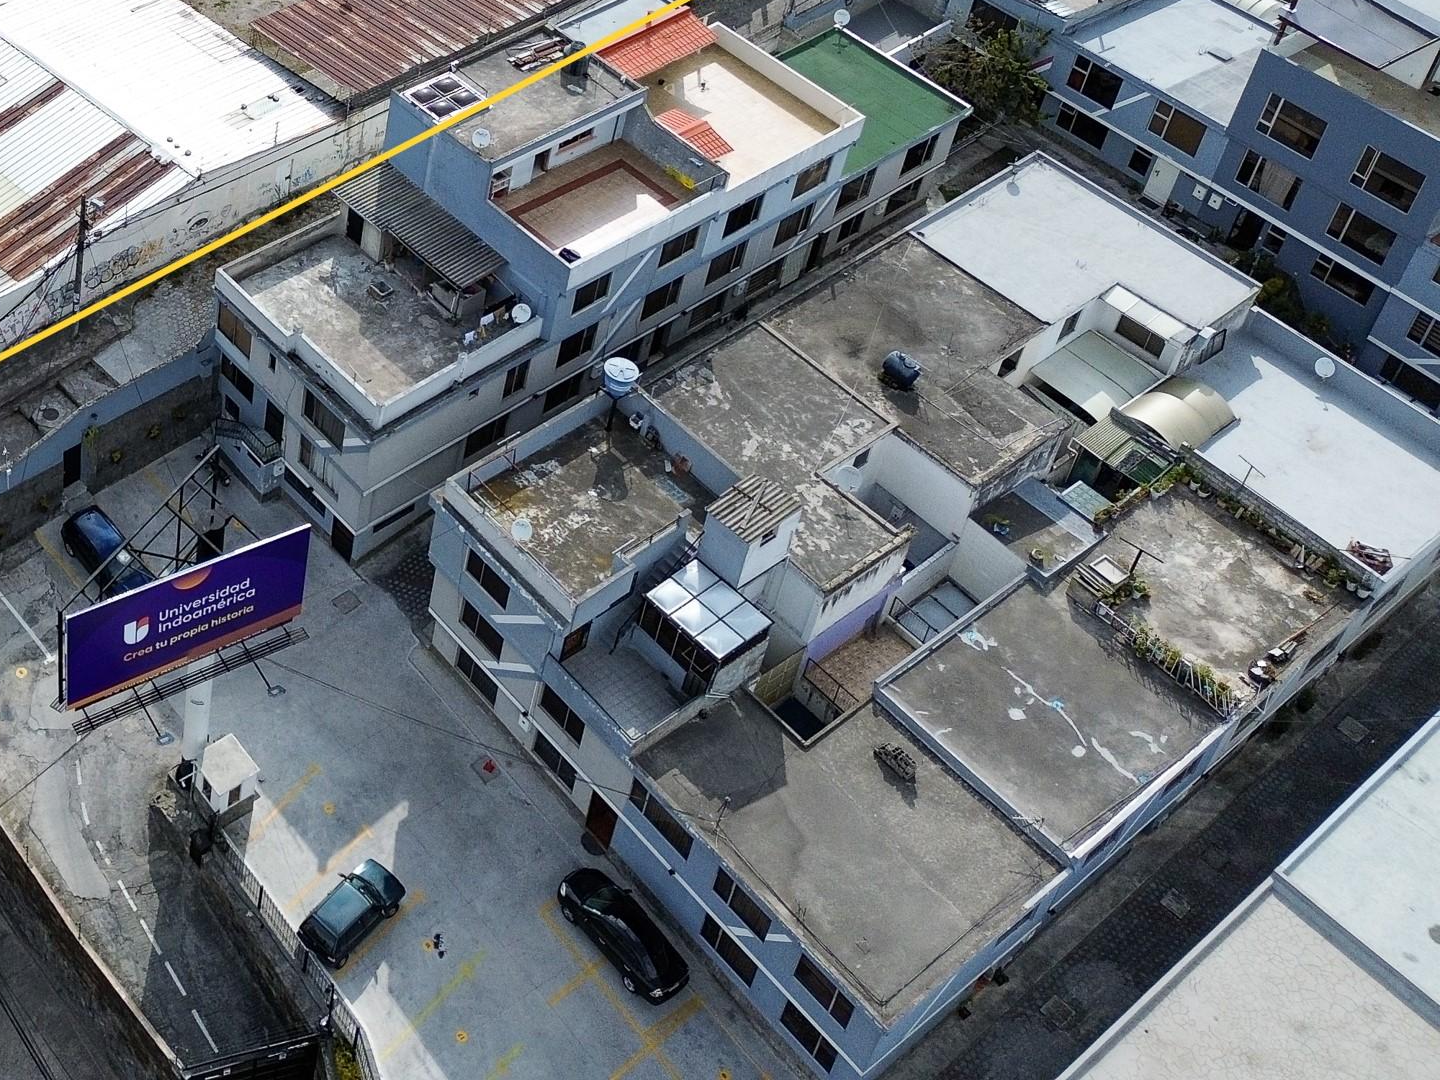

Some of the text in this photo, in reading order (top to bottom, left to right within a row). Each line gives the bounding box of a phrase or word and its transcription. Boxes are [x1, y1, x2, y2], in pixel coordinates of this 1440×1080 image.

[158, 588, 256, 633] Indoamérica
[159, 578, 251, 622] Universidad
[123, 604, 255, 663] Crea tu propia historia
